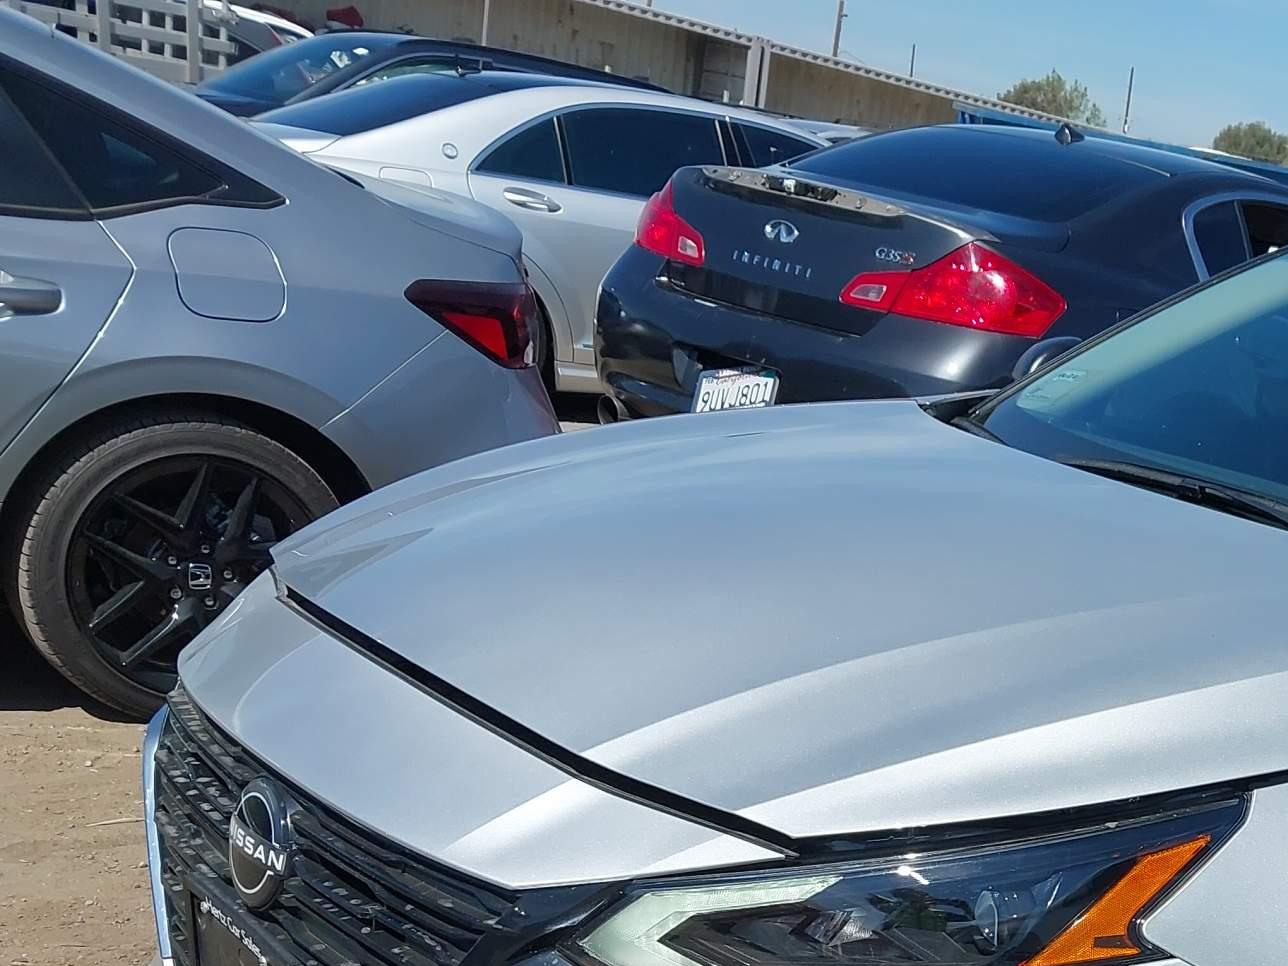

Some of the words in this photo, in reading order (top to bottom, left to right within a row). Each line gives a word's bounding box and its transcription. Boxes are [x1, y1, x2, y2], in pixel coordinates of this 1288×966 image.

[732, 249, 811, 278] INFINITI
[701, 382, 768, 411] 9UVJ801
[230, 819, 284, 871] NISSAN
[205, 896, 228, 927] Hertz
[227, 916, 241, 939] Car
[240, 929, 262, 958] Sales
